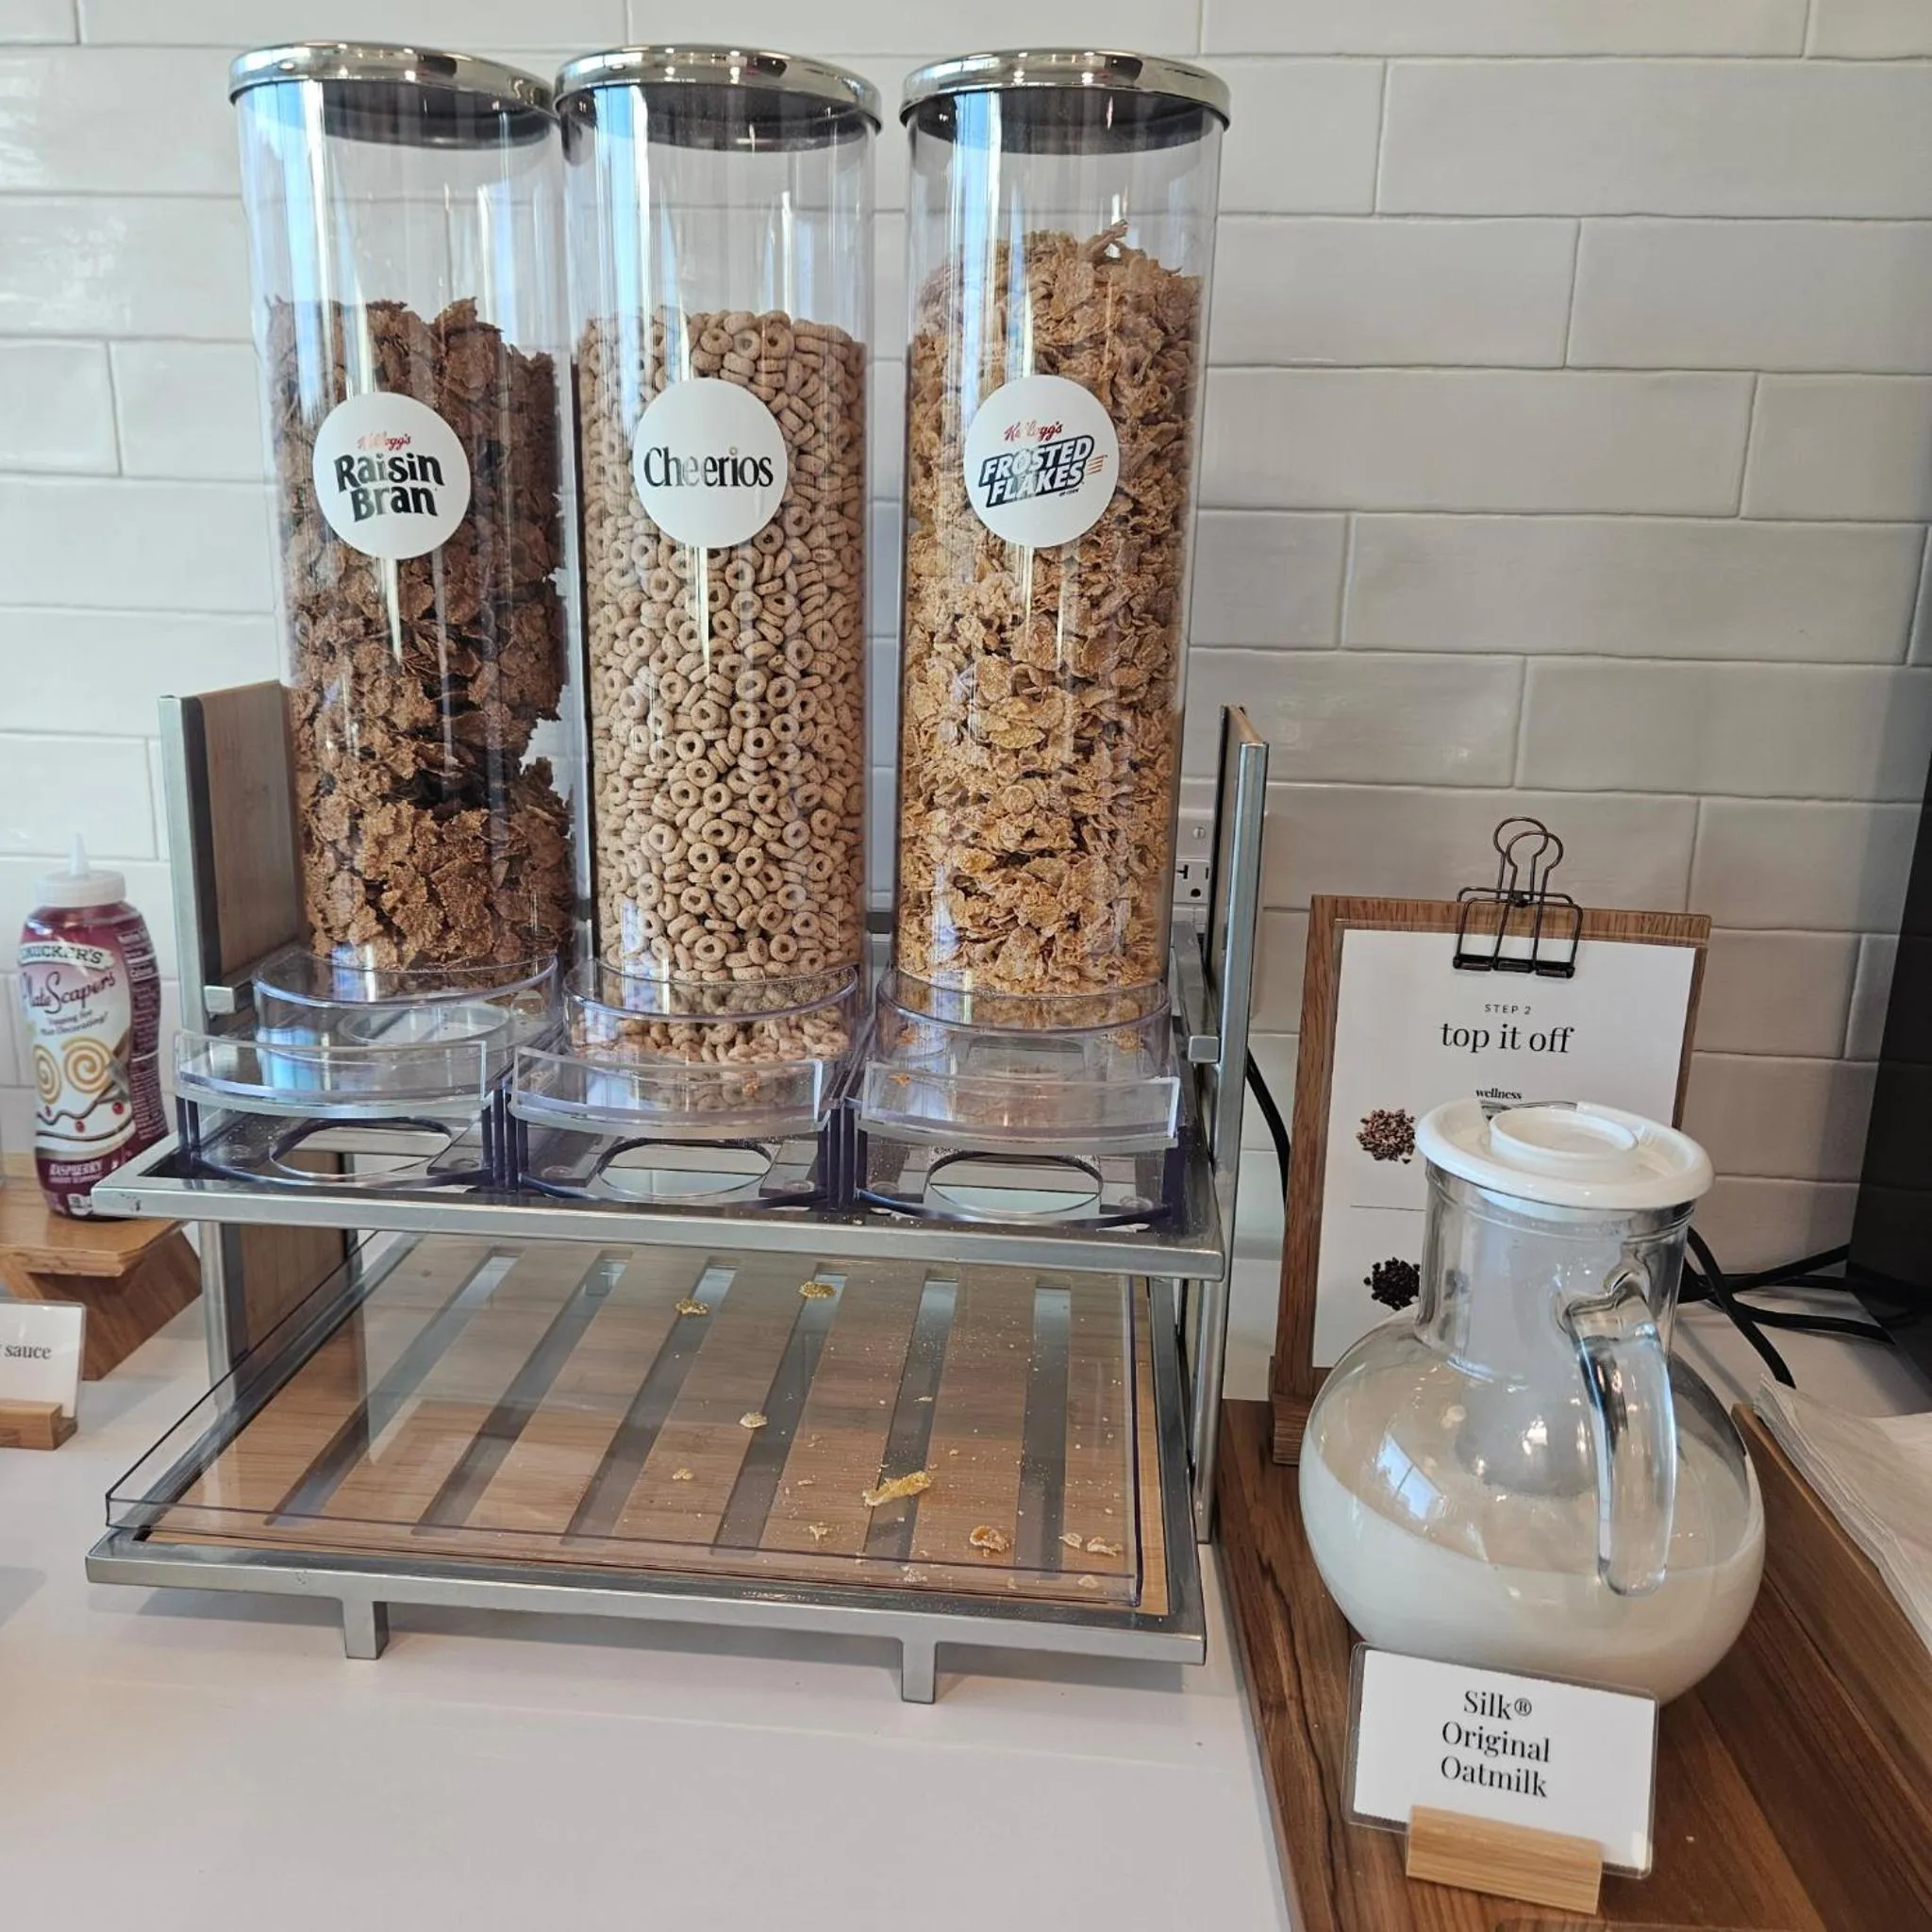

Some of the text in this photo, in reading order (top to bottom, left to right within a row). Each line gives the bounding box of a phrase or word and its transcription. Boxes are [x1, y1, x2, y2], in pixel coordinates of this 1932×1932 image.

[357, 431, 412, 451] Kogg's
[1003, 420, 1064, 442] Kelgg's
[334, 452, 445, 493] Raisin
[643, 446, 774, 488] Cheerios
[979, 437, 1094, 487] FROSTED
[987, 461, 1085, 508] FLAKES
[350, 486, 439, 523] Bran
[21, 945, 104, 964] UCKR'S
[1484, 1004, 1532, 1015] STEP 2
[1441, 1024, 1575, 1054] top it off
[1475, 1088, 1523, 1100] wellness
[4, 1344, 52, 1359] sauce
[1463, 1690, 1533, 1721] Silk®
[1441, 1721, 1550, 1763] Original
[1441, 1756, 1548, 1798] Oatmilk
